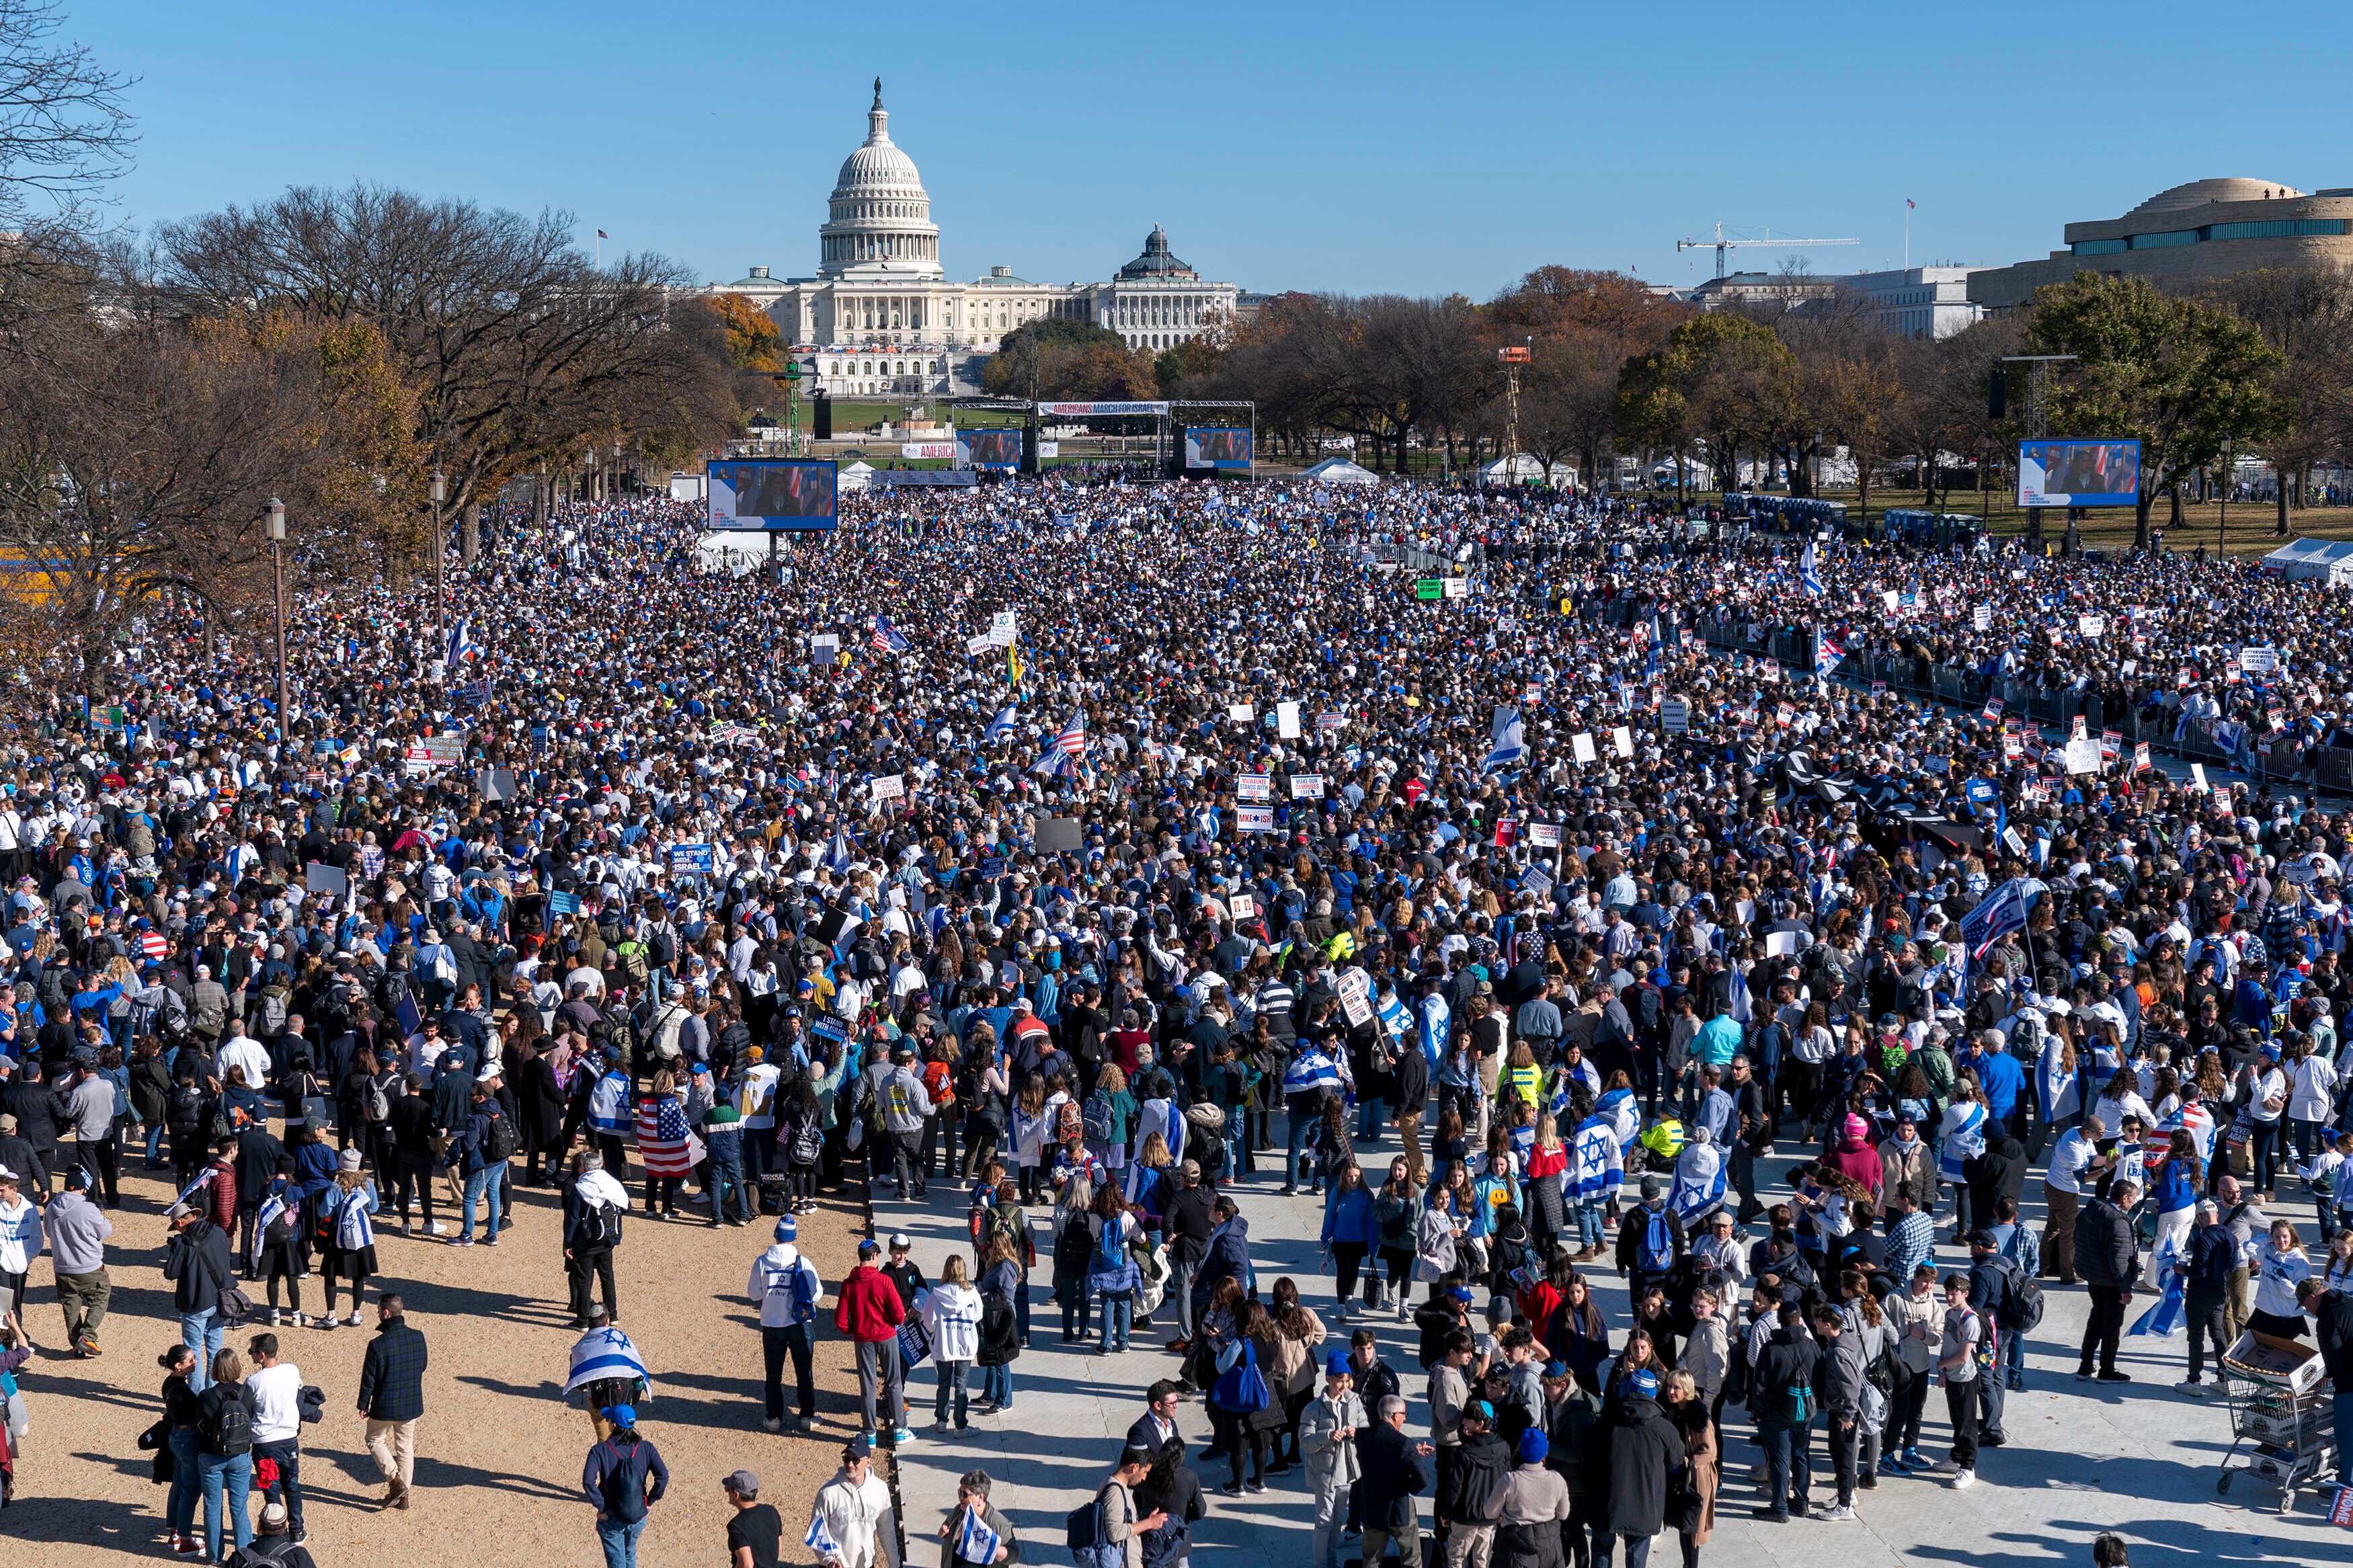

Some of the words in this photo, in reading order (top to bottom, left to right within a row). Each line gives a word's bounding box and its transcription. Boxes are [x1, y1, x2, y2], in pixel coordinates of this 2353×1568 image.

[1053, 404, 1092, 414] AMERICANS
[1093, 404, 1117, 413] MARCH
[1119, 404, 1131, 413] FOR
[1131, 404, 1155, 413] ISRAEL
[920, 445, 956, 458] AMERICA
[972, 643, 990, 653] HAMAS
[465, 683, 476, 691] OUR
[711, 724, 721, 732] FREE
[713, 725, 735, 735] HOSTAGES
[714, 733, 725, 742] FROM
[873, 778, 892, 786] BRING
[877, 790, 901, 798] HOME
[674, 863, 702, 871] ISRAEL
[1527, 876, 1537, 885] WITH
[1529, 873, 1544, 885] STANDS
[1532, 869, 1546, 882] DALLAS
[1525, 879, 1537, 889] ISRAEL
[826, 1016, 843, 1028] STAND
[815, 1020, 829, 1031] WITH
[829, 1026, 846, 1037] ISRAEL
[2235, 1115, 2254, 1126] AGAIN
[2231, 1125, 2251, 1135] NEVER
[2228, 1133, 2247, 1144] AGAIN
[909, 1327, 924, 1349] STAND
[904, 1335, 921, 1362] ISRAEL
[2335, 1489, 2353, 1524] HOME
[838, 1506, 879, 1525] GAP
